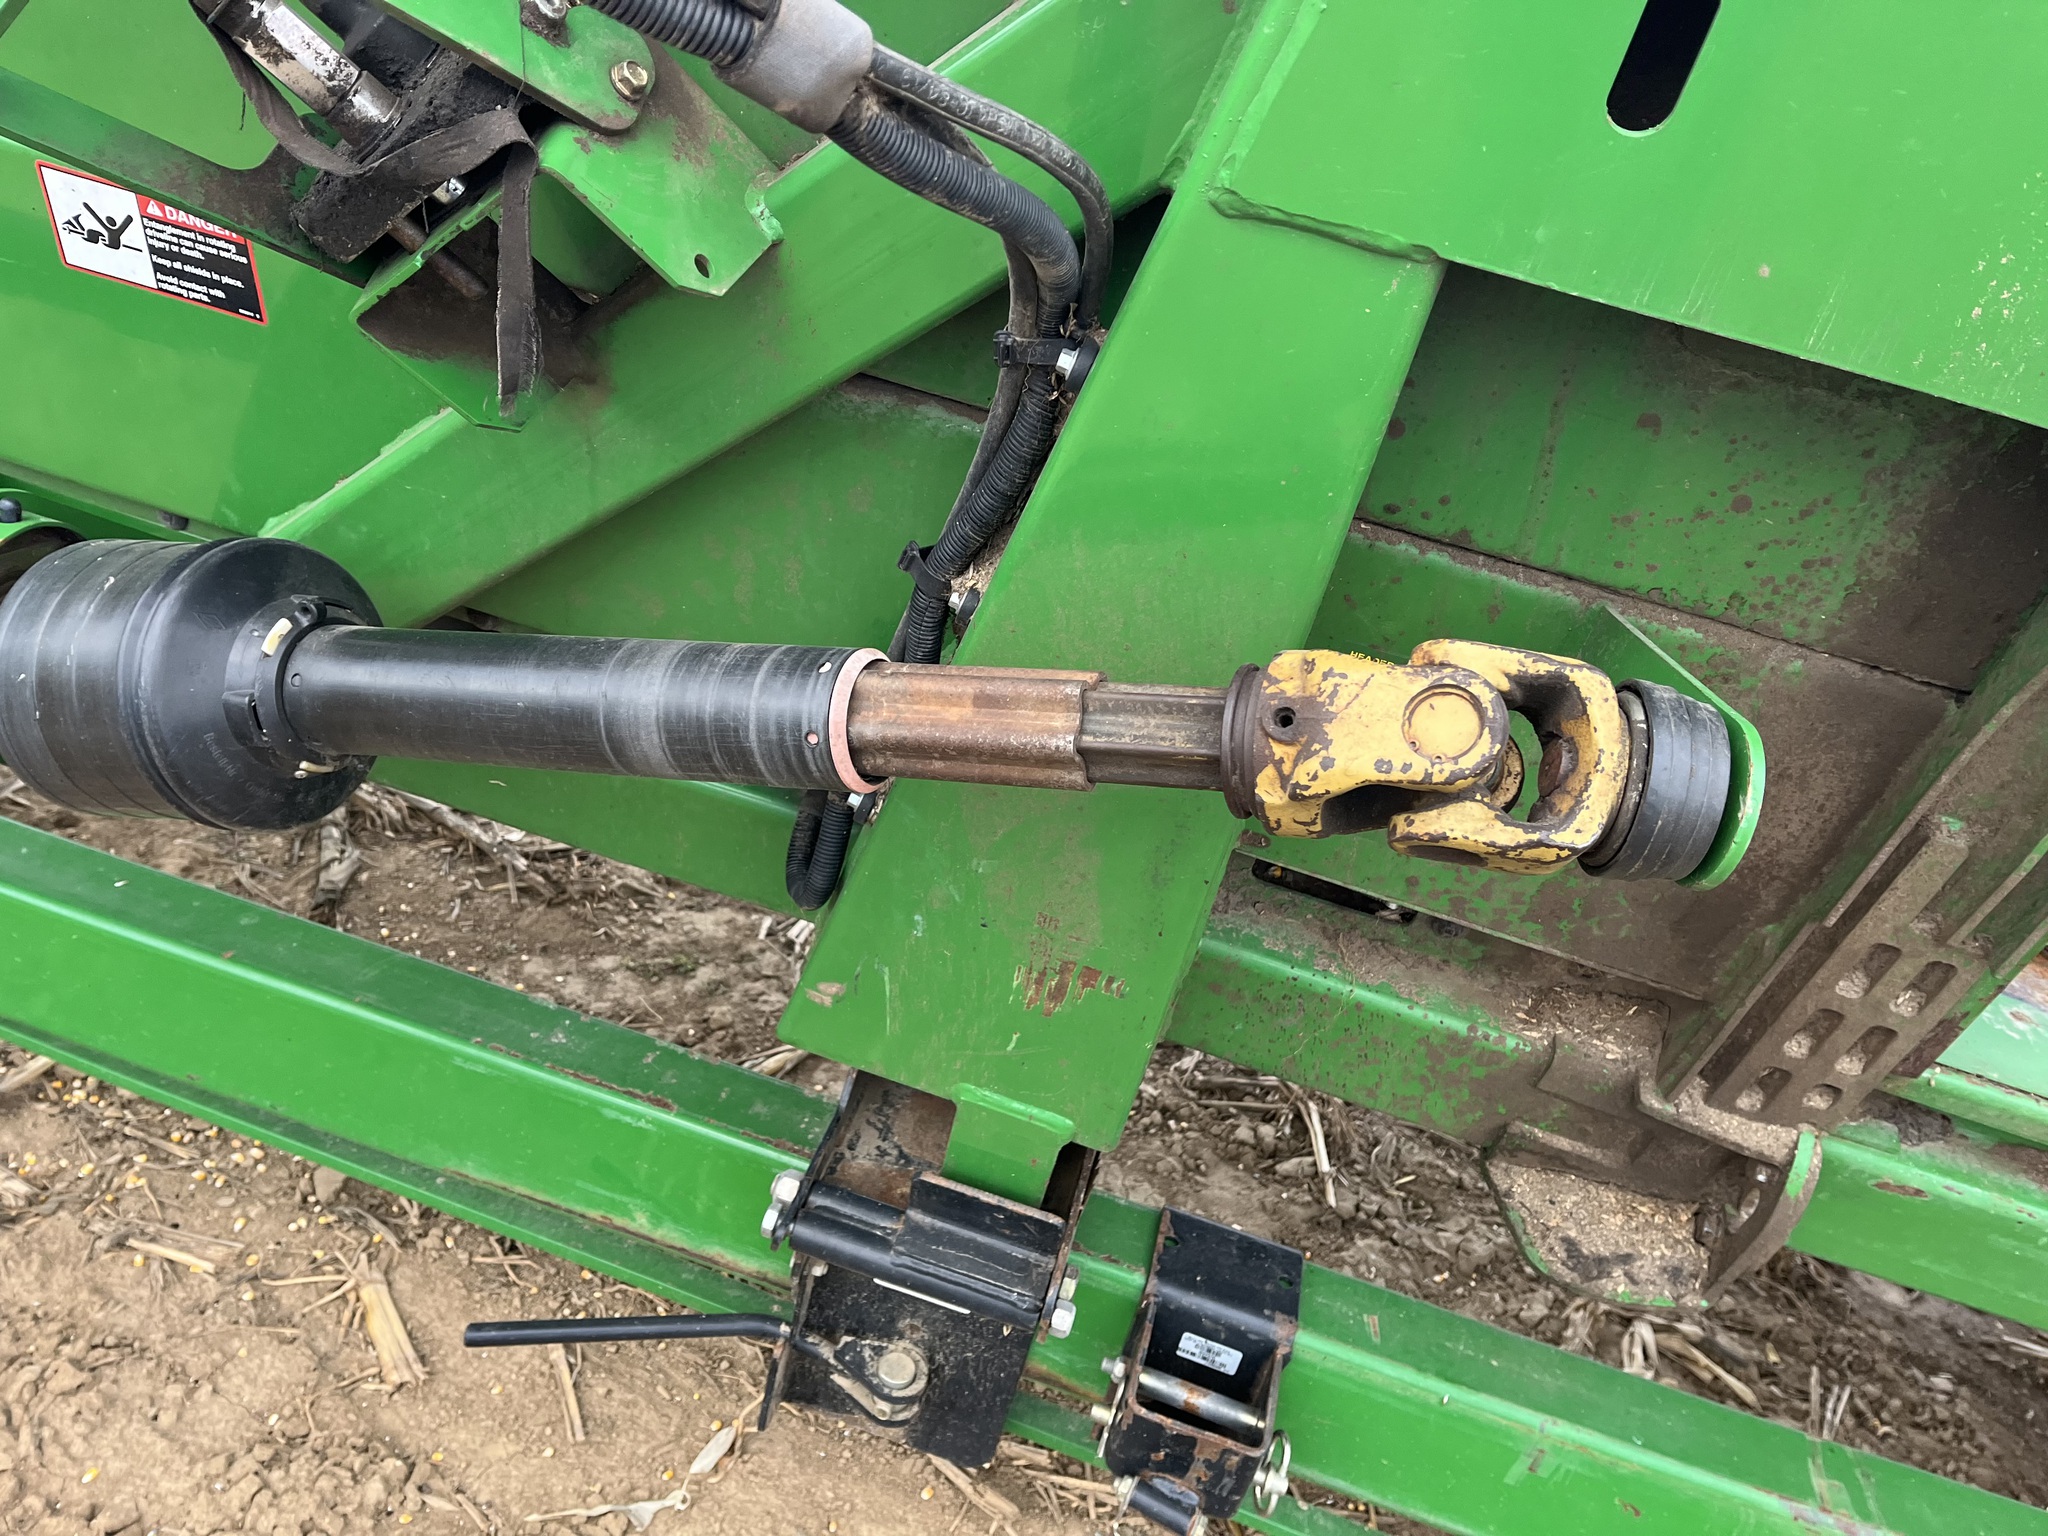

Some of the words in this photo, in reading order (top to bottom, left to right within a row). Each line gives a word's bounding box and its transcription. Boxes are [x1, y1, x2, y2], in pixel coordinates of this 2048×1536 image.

[142, 217, 196, 240] Entanglement
[196, 232, 205, 242] in
[205, 237, 236, 253] rotating
[145, 228, 178, 244] driveline
[179, 238, 194, 248] can
[195, 243, 218, 255] cause
[219, 250, 248, 264] serious
[147, 236, 169, 251] injury
[170, 244, 179, 252] or
[180, 246, 205, 260] death.
[151, 253, 172, 268] Keep
[172, 261, 183, 270] all
[183, 264, 211, 278] shields
[211, 271, 220, 281] in
[220, 275, 245, 288] place.
[156, 271, 178, 285] Avoid
[179, 280, 208, 293] contact
[208, 288, 226, 299] with
[158, 282, 188, 297] rotating
[188, 291, 211, 302] parts.
